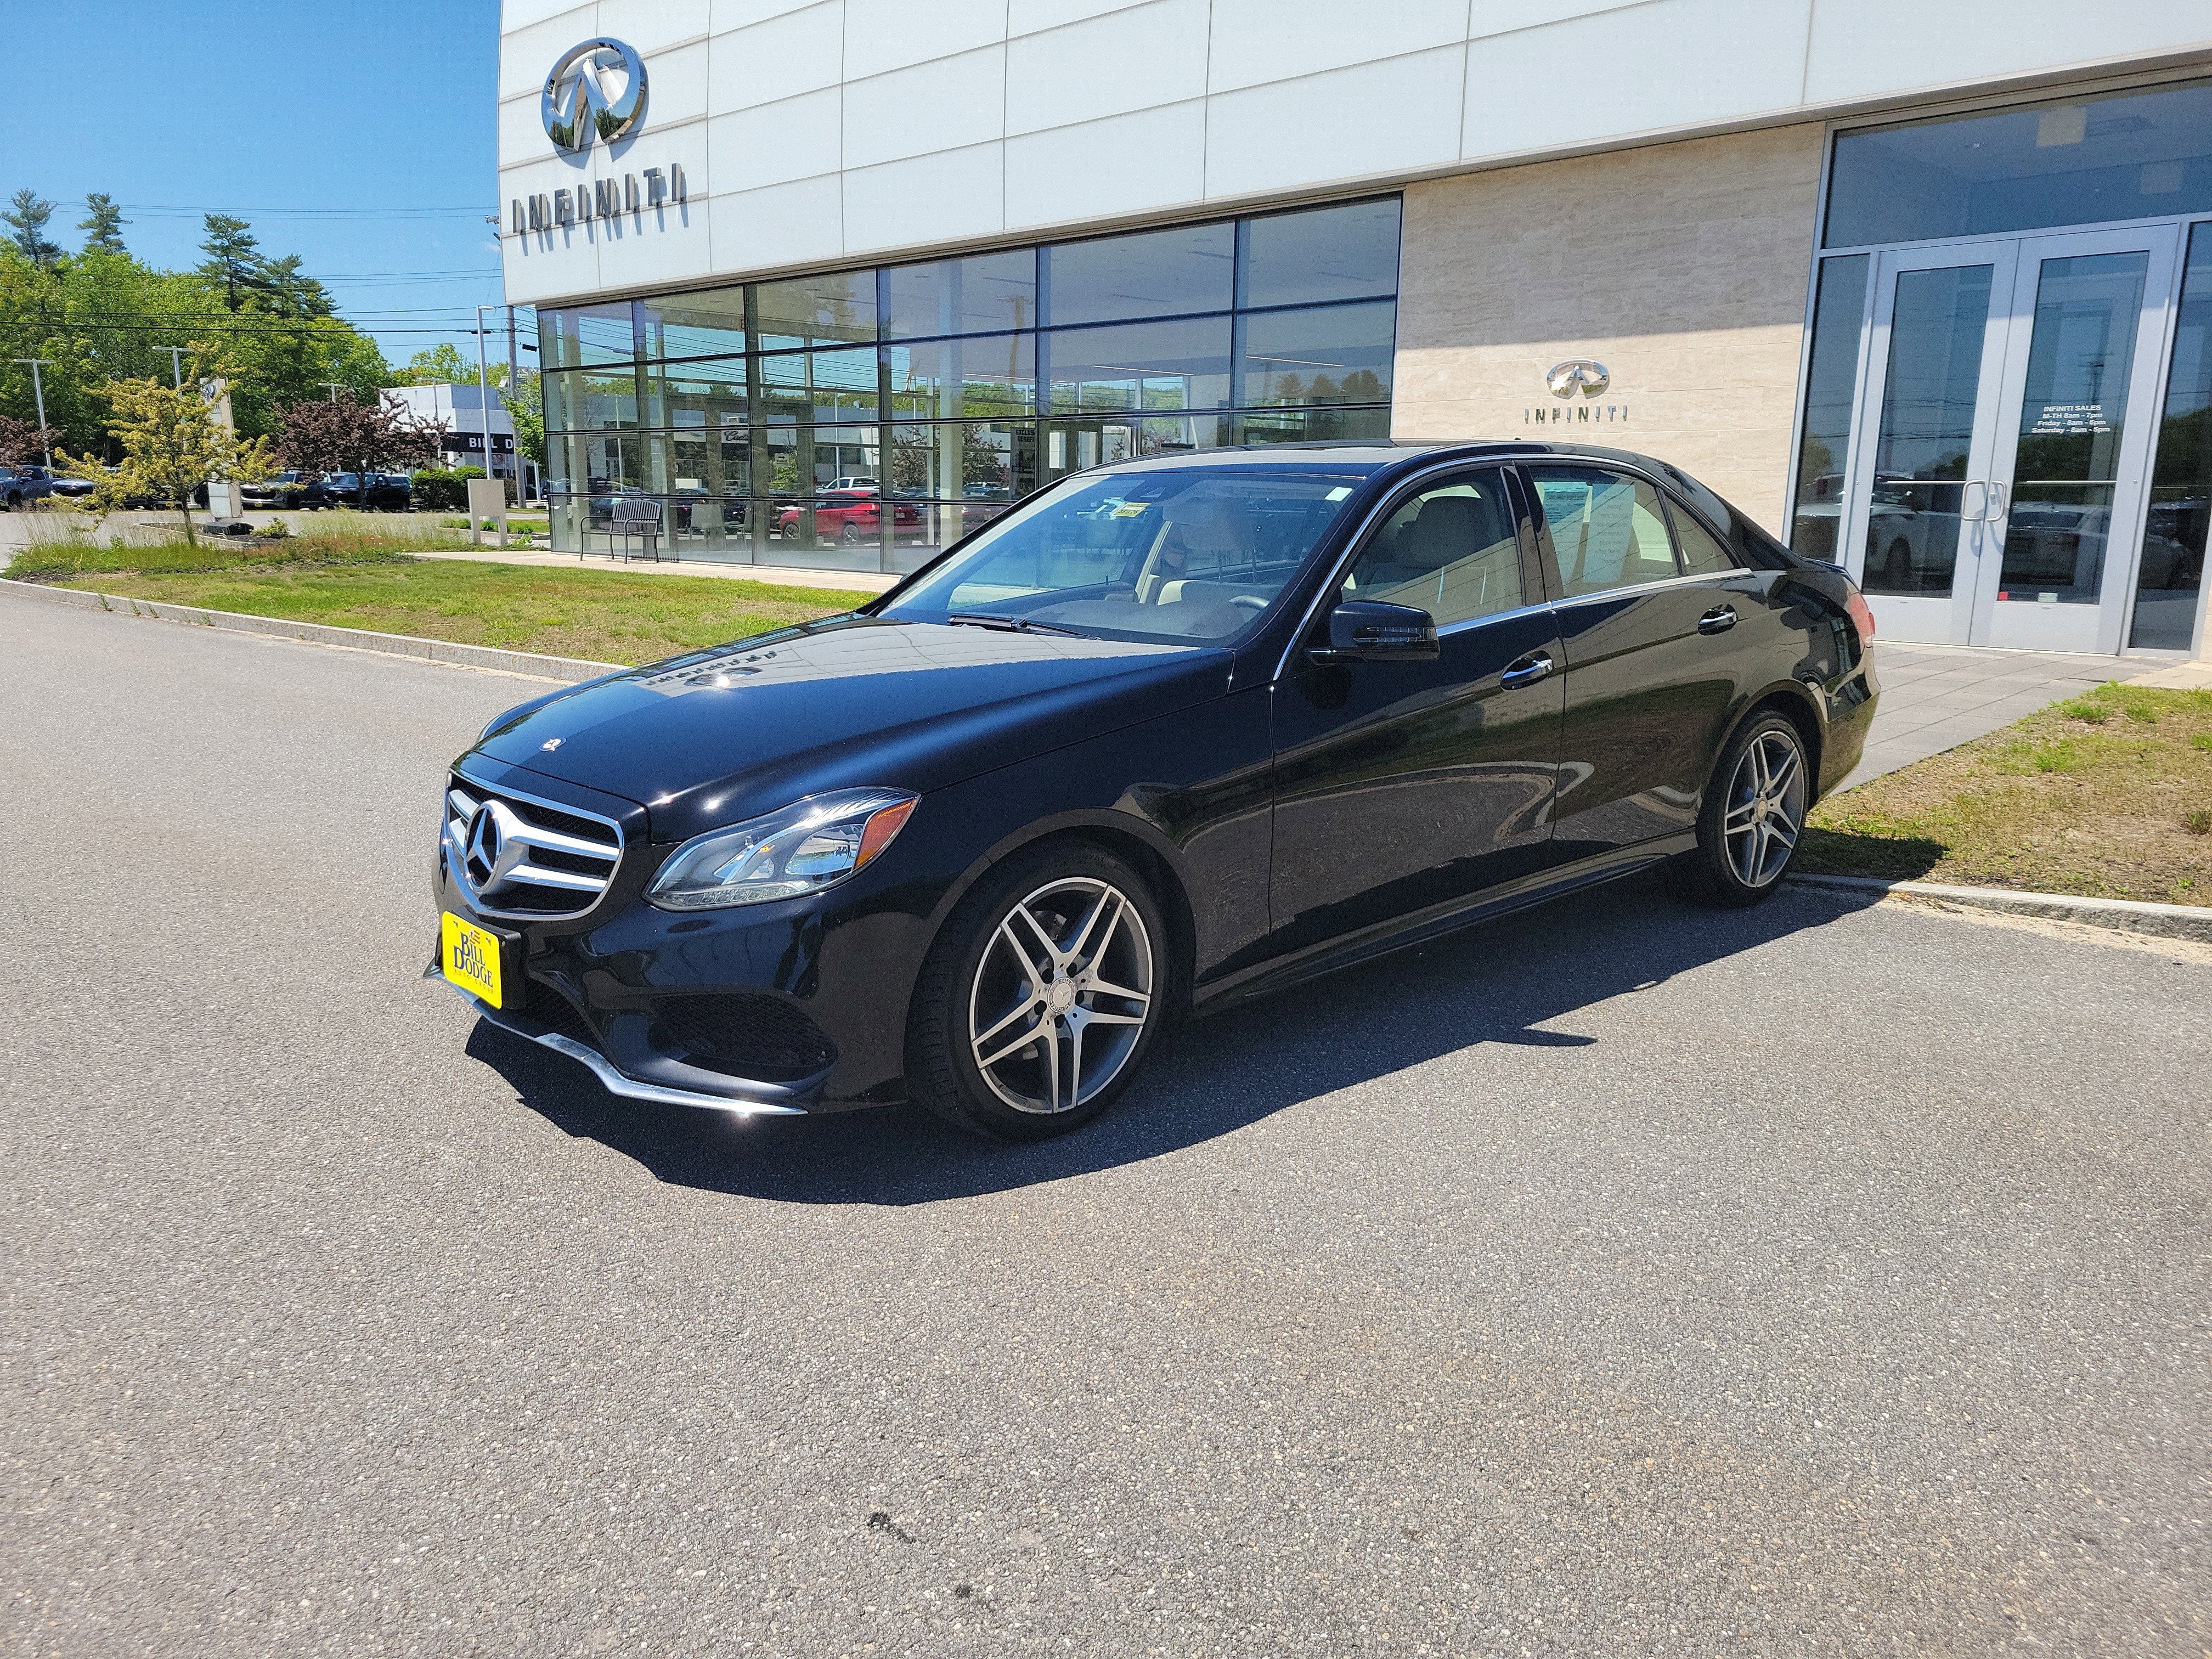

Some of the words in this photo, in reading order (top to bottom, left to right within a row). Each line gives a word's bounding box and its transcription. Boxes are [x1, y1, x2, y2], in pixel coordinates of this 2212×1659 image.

[512, 163, 681, 234] INFINITI
[1525, 405, 1627, 424] INFINITI
[454, 945, 493, 988] DODGE
[460, 932, 486, 966] BILL
